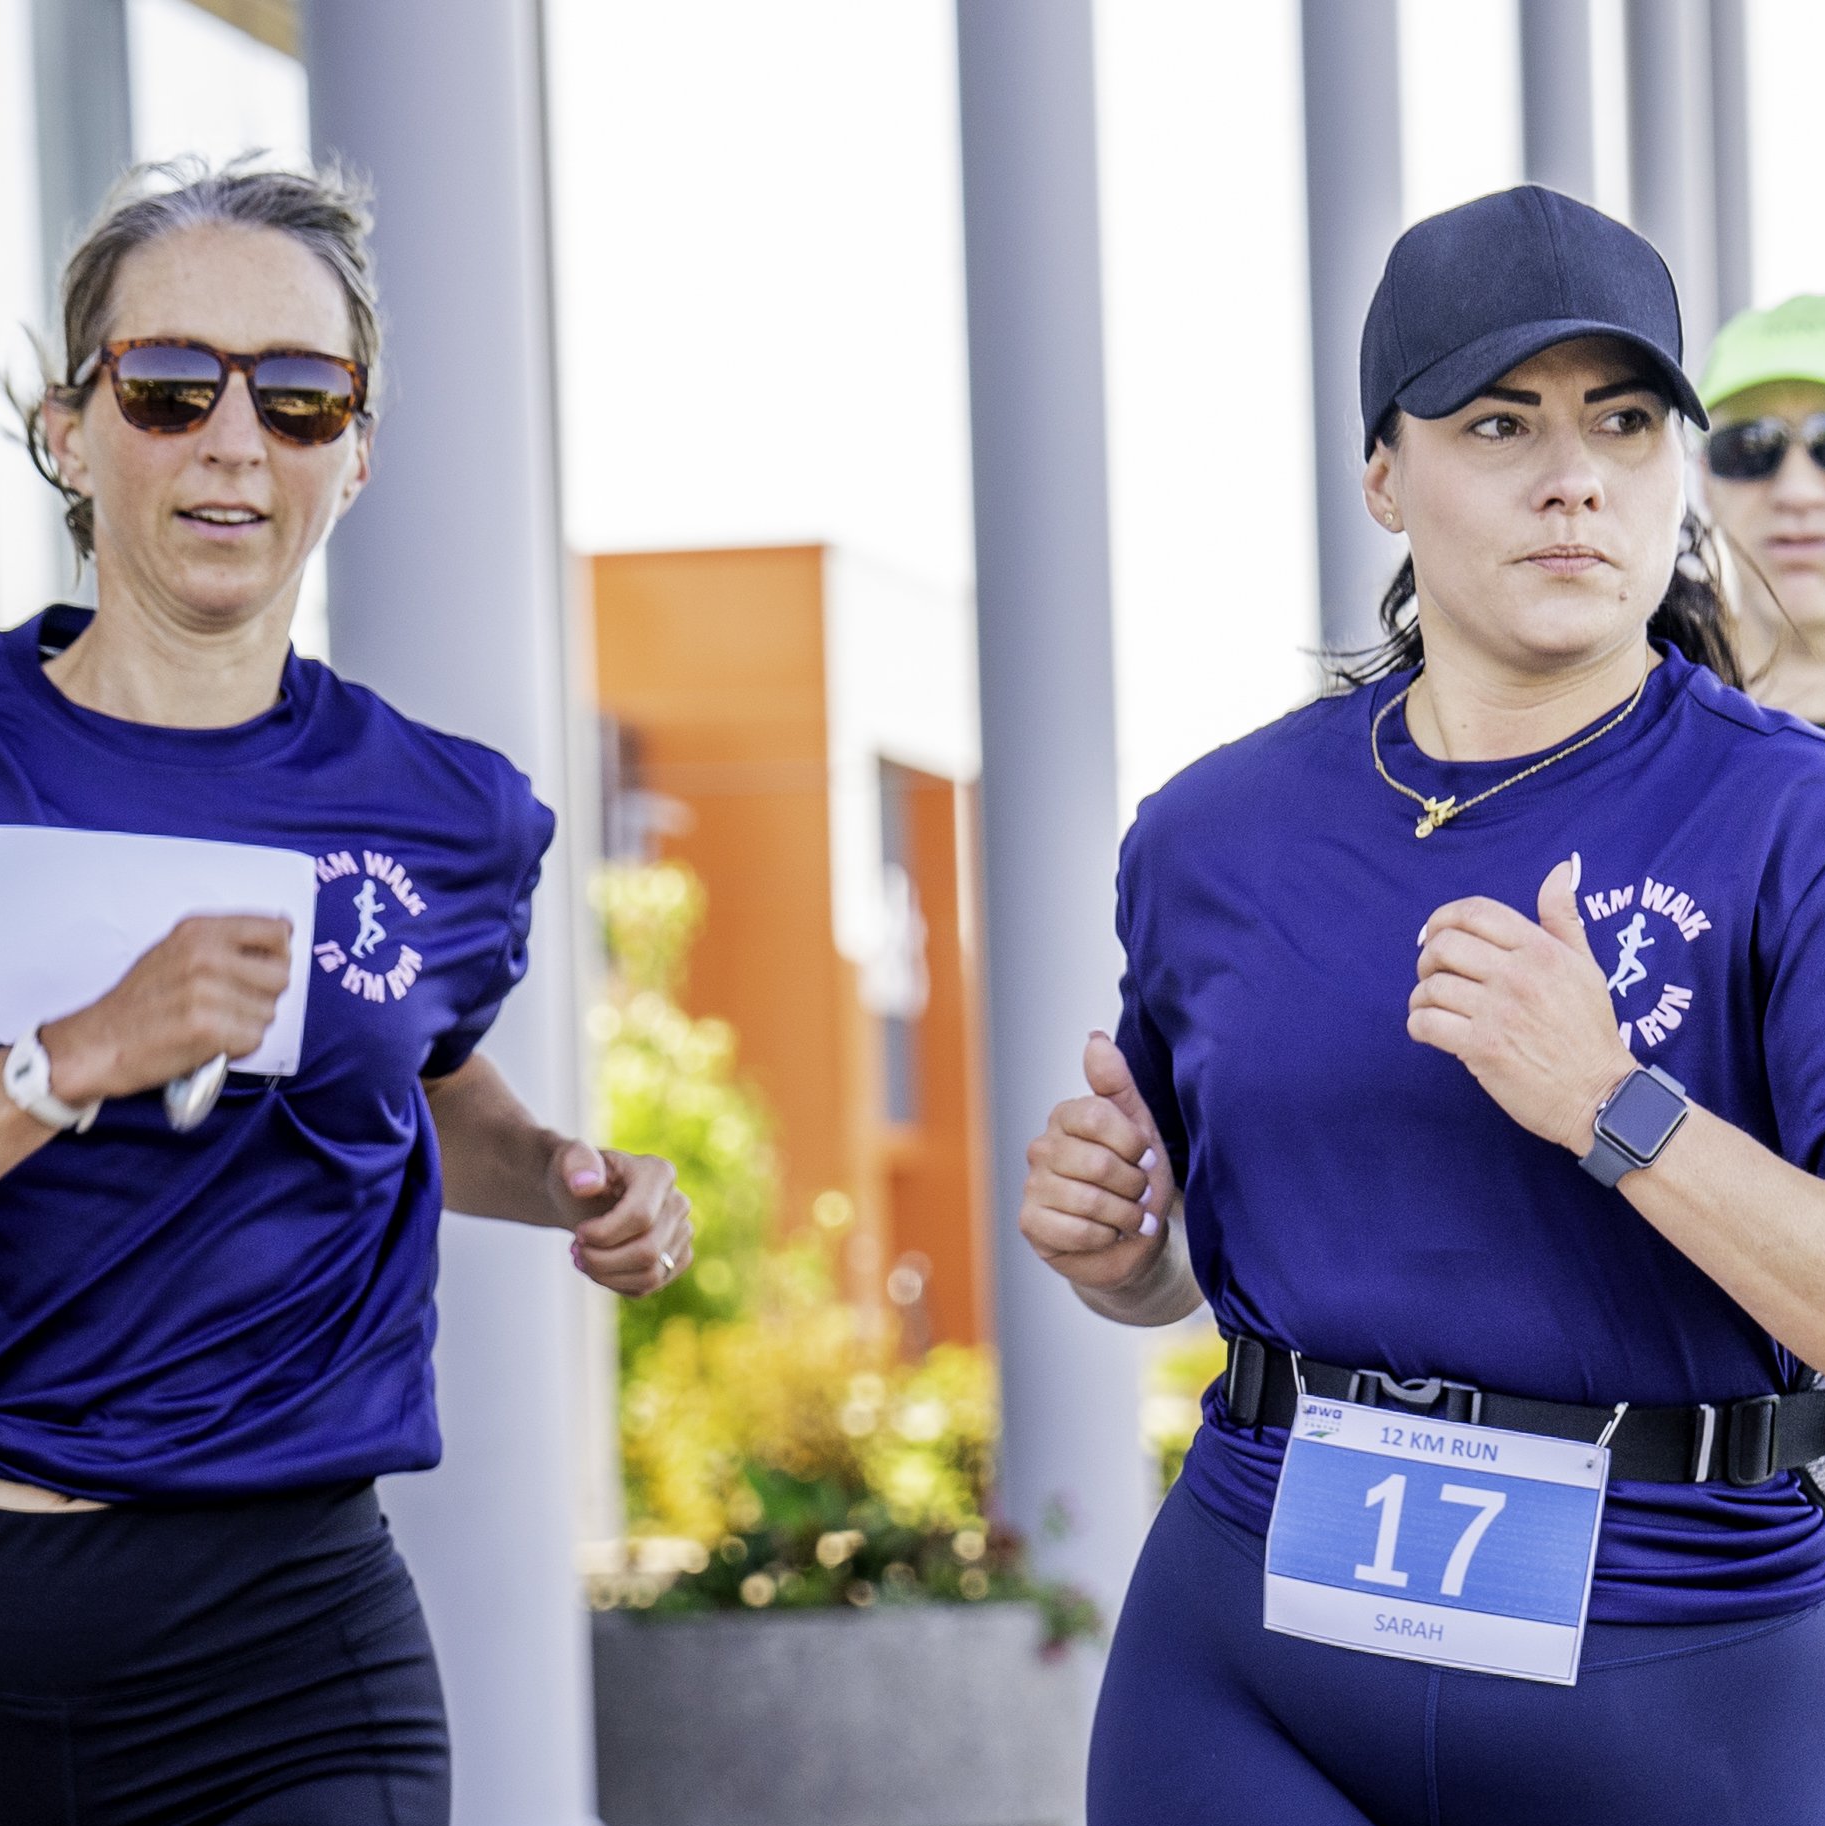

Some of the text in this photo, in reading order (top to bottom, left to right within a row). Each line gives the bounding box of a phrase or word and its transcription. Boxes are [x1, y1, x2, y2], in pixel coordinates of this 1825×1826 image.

[316, 849, 427, 917] KM WALK
[1584, 876, 1712, 942] KM WALK
[313, 940, 423, 1003] 12 KM RUN
[1636, 983, 1693, 1047] RUN
[1379, 1426, 1499, 1462] 12 KM RUN
[1353, 1473, 1507, 1597] 17
[1373, 1613, 1444, 1642] SARAH
